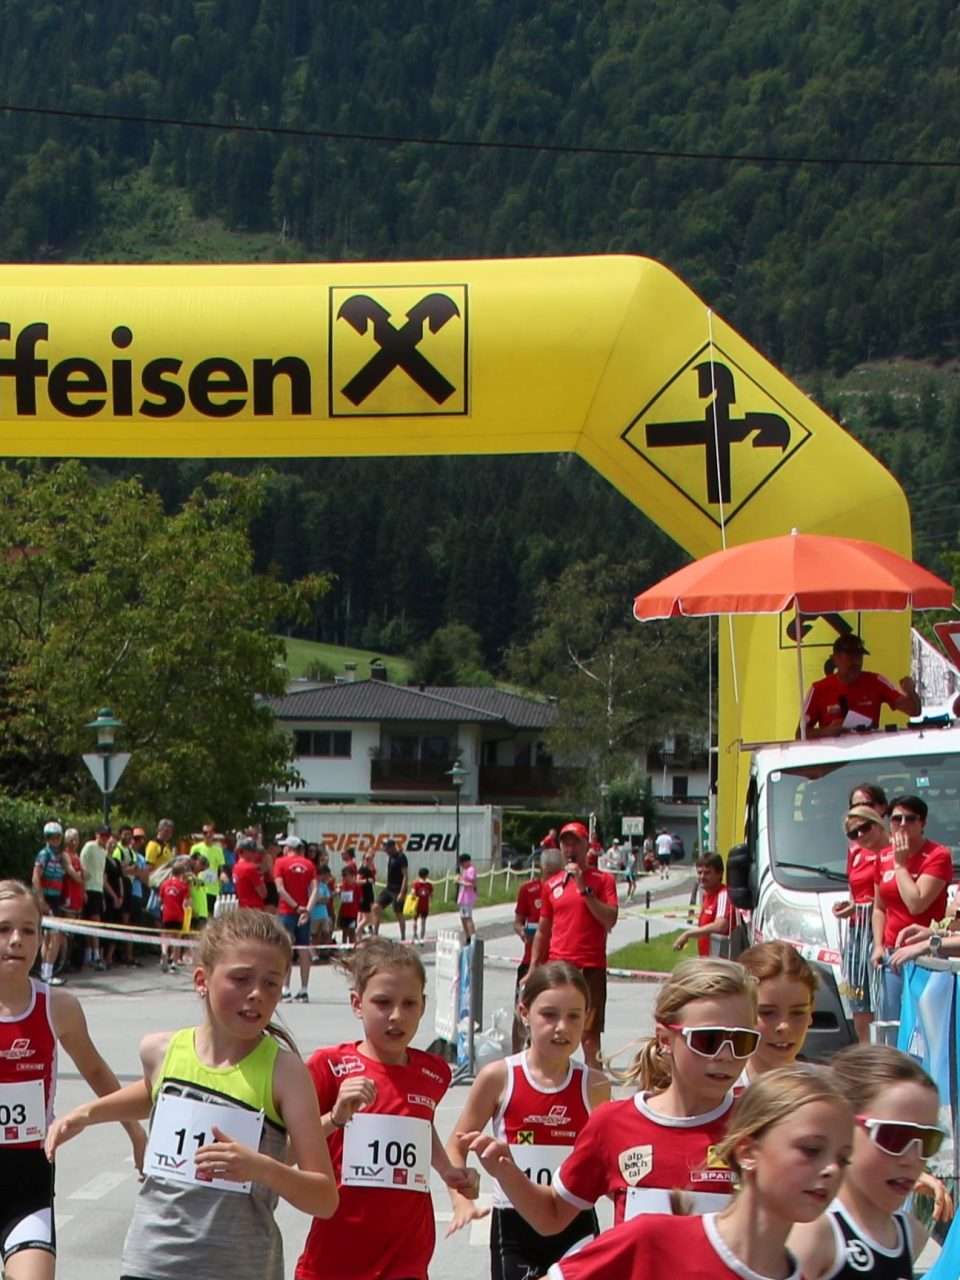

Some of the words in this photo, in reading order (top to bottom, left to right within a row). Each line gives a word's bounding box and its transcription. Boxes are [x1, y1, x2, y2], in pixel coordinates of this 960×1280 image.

[175, 1128, 217, 1155] 11
[368, 1140, 417, 1167] 106
[524, 1168, 552, 1186] 10
